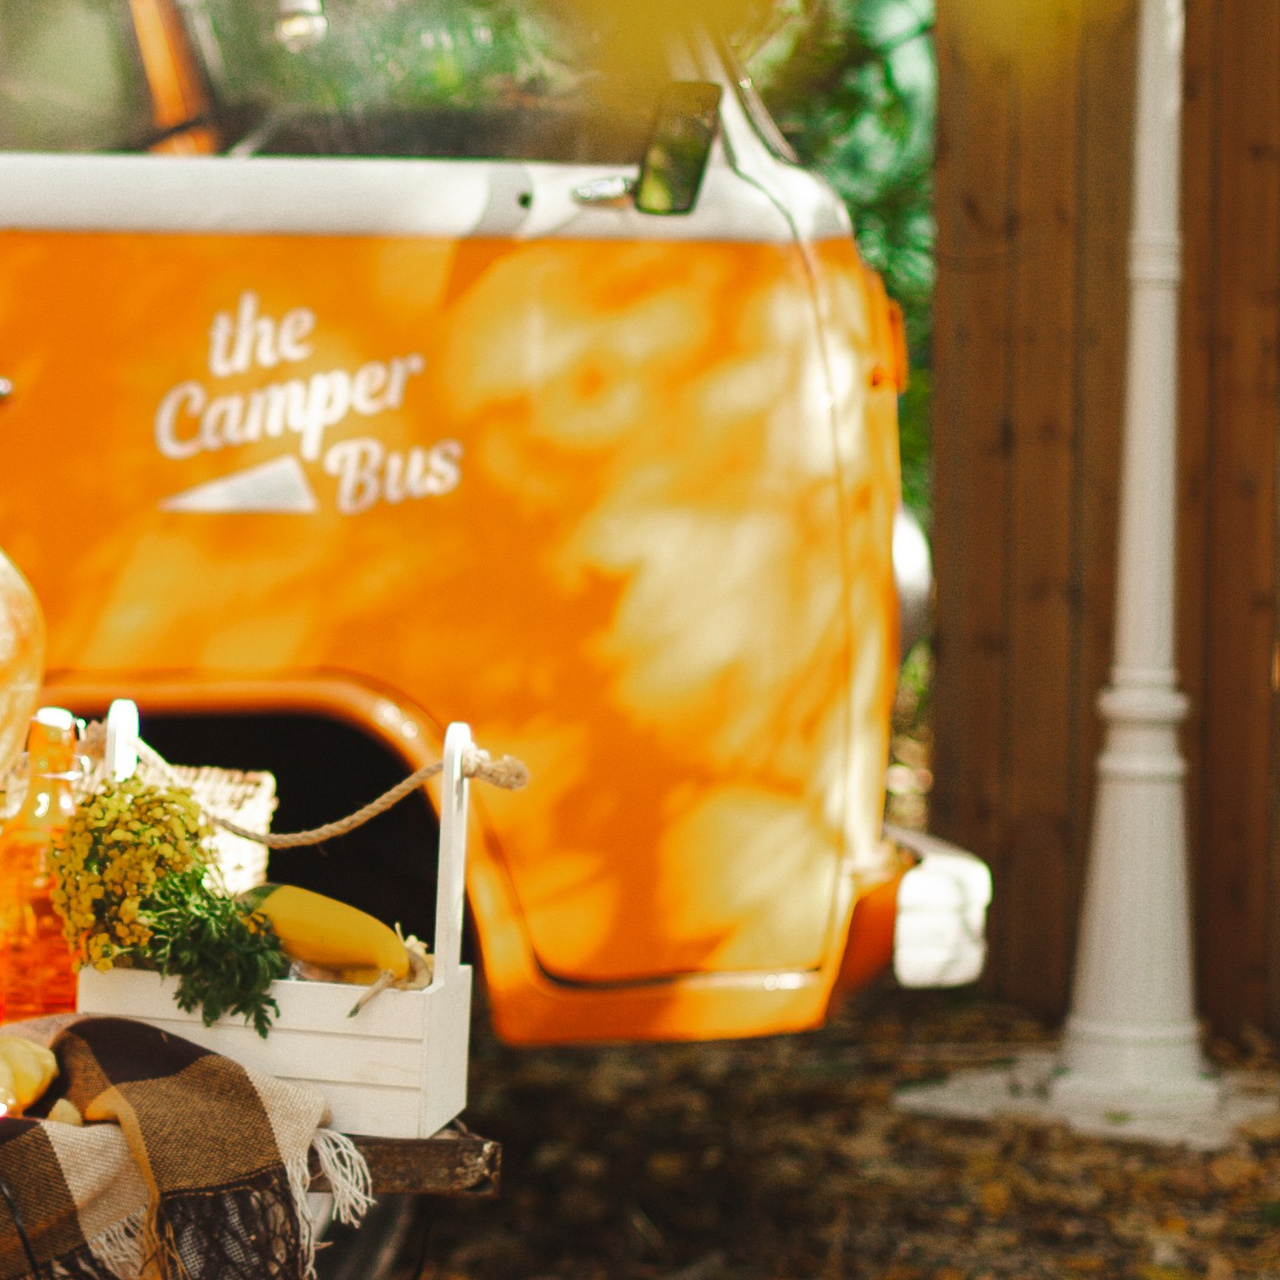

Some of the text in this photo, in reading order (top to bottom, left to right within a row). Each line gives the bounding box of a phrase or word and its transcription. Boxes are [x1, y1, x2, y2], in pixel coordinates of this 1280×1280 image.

[209, 290, 317, 377] the
[154, 353, 426, 461] Camper
[324, 437, 464, 515] Bus
